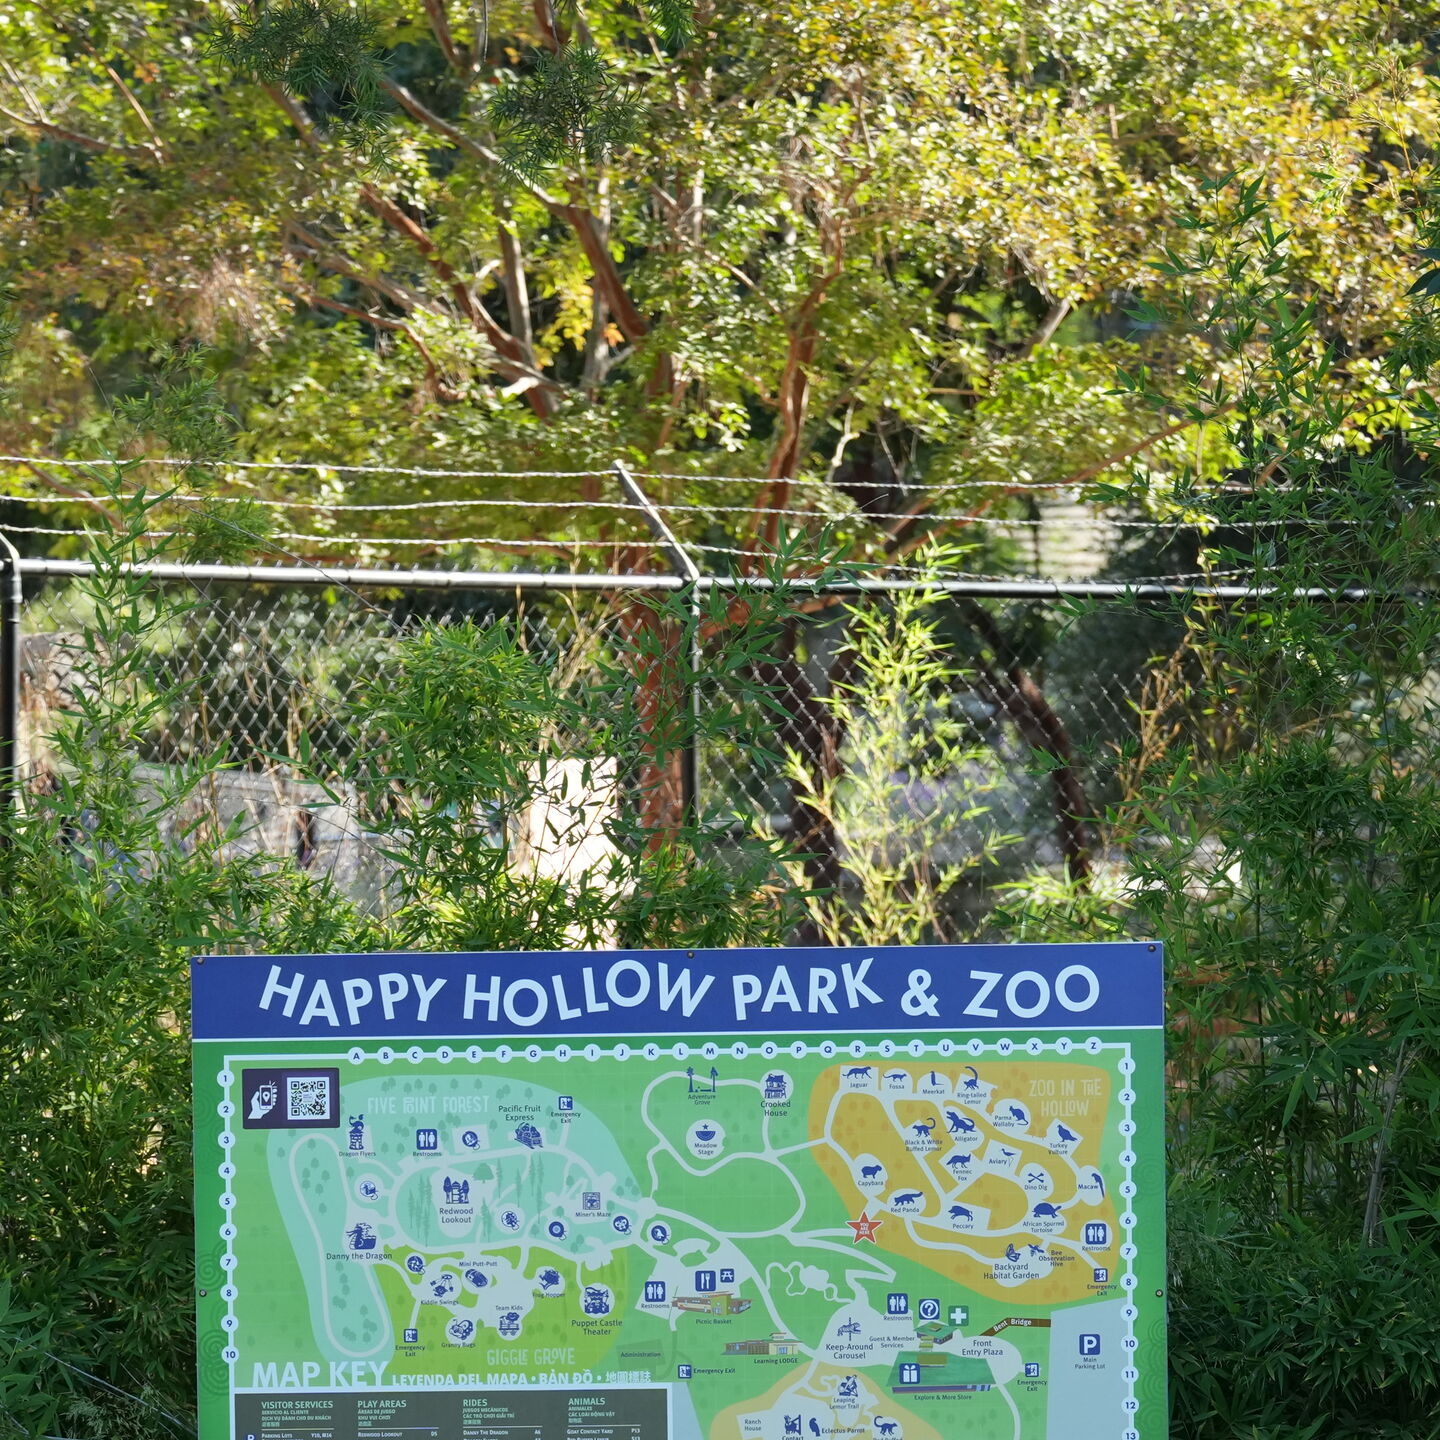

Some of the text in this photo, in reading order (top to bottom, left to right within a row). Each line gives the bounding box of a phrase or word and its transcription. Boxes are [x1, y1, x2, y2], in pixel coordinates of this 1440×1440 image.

[259, 957, 1101, 1026] HAPPY HOLLOW PARK & ZOO
[529, 1050, 537, 1058] G
[559, 1049, 567, 1057] H
[590, 1049, 594, 1057] I
[620, 1049, 624, 1057] J
[648, 1048, 655, 1056] K
[679, 1048, 684, 1056] L
[705, 1047, 715, 1055] M
[736, 1047, 743, 1055] N
[765, 1046, 773, 1054] O
[796, 1046, 802, 1054] P
[855, 1045, 861, 1053] R
[884, 1045, 890, 1053] S
[943, 1044, 950, 1052] U
[972, 1043, 980, 1051] V
[1000, 1043, 1010, 1051] W
[1031, 1042, 1038, 1050] X
[1061, 1042, 1067, 1050] Y
[1090, 1042, 1097, 1050] Z
[498, 1104, 541, 1113] Pacific Fruit
[760, 1100, 791, 1108] Crooked
[505, 1113, 534, 1122] Express
[764, 1109, 788, 1117] House
[439, 1207, 474, 1215] Redwood
[441, 1216, 472, 1224] Lookout
[326, 1252, 350, 1261] Danny
[351, 1252, 364, 1260] the
[994, 1263, 1029, 1272] Backyard
[983, 1272, 1040, 1280] Habitat Garden
[571, 1319, 623, 1328] Puppet Castle
[993, 1318, 1032, 1333] Bent Bridge
[583, 1328, 612, 1336] Theater
[825, 1343, 875, 1352] Keep-Around
[972, 1339, 992, 1347] Front
[1083, 1336, 1097, 1353] P
[961, 1348, 1003, 1357] Entry Plaza
[252, 1360, 389, 1388] MAP KEY
[392, 1373, 454, 1387] LEYENDA
[458, 1373, 481, 1385] DEL
[486, 1372, 526, 1385] MAPA
[261, 1400, 334, 1409] VISITOR SERVICES
[357, 1400, 407, 1408] PLAY AREAS
[462, 1399, 488, 1407] RIDES
[568, 1398, 606, 1406] ANIMALS
